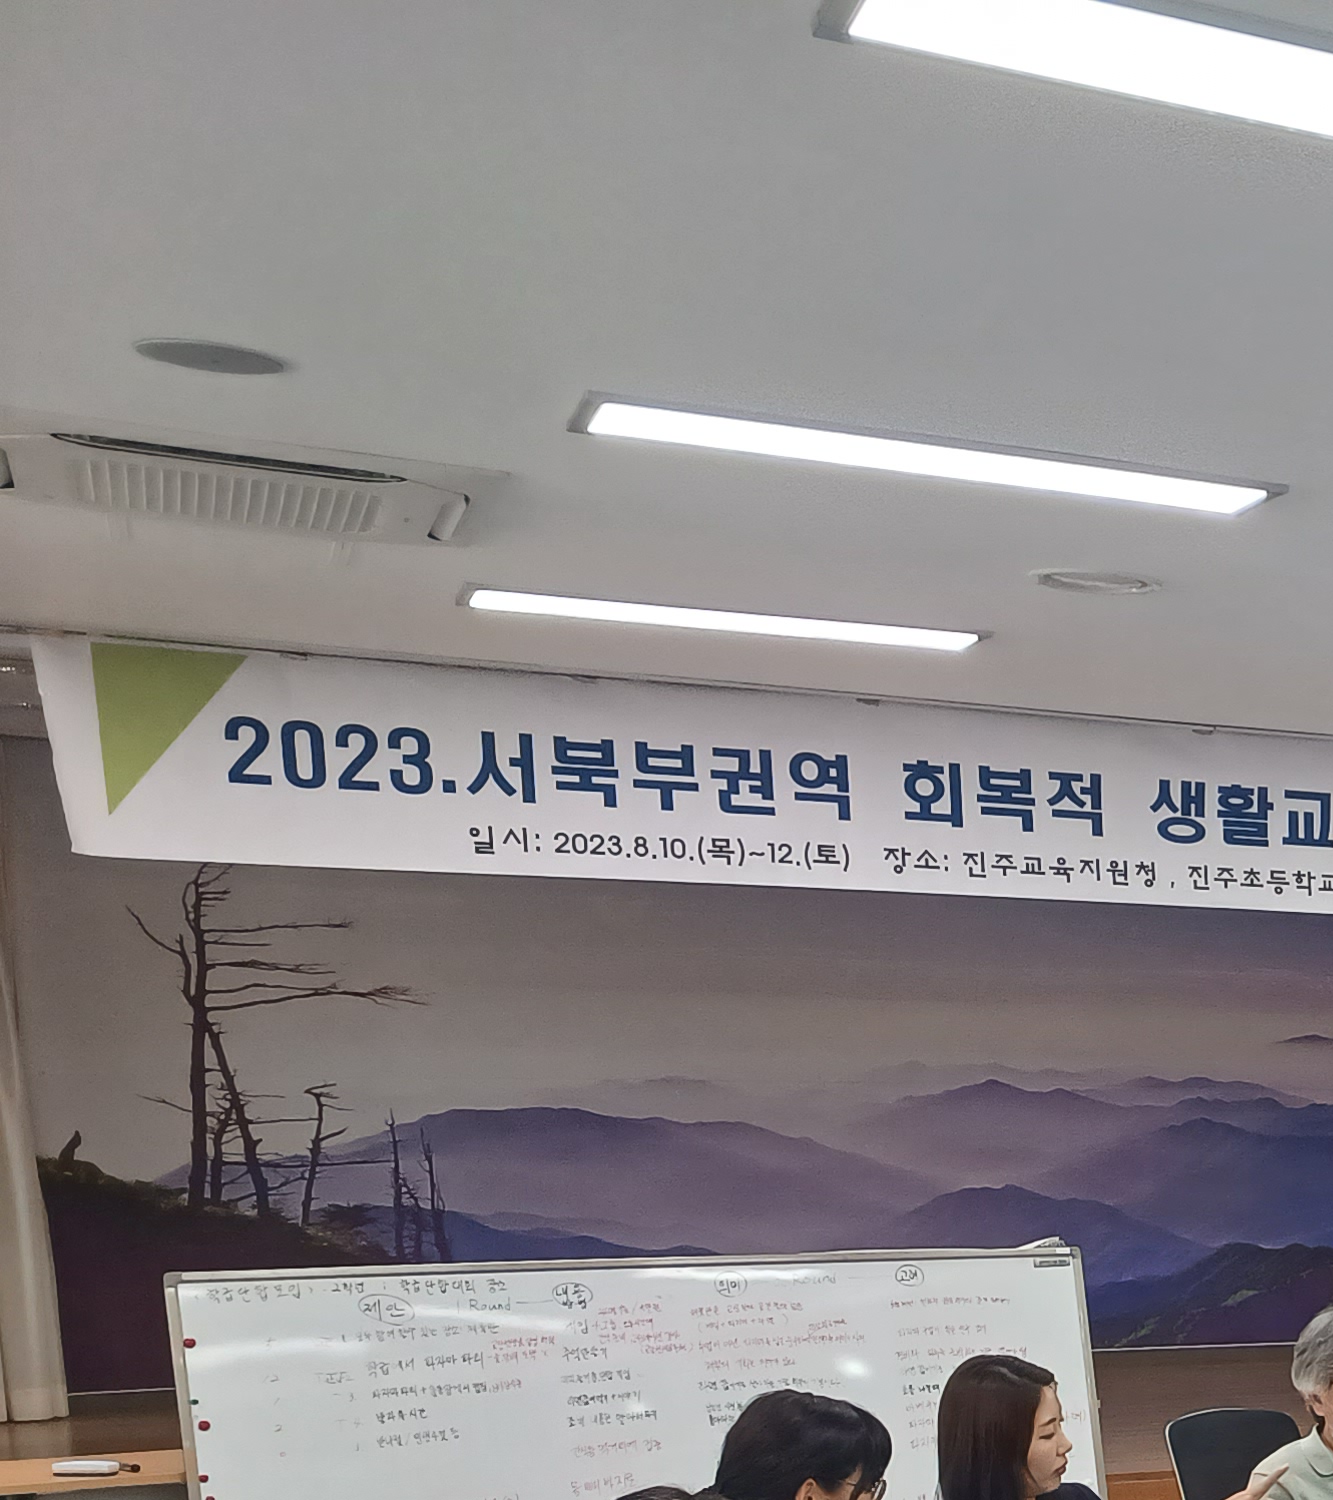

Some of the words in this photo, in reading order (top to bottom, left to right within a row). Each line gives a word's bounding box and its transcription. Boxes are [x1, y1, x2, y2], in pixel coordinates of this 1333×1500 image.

[224, 715, 852, 822] 2023.서북부권역
[902, 759, 1105, 838] 회복적
[469, 825, 541, 855] 일시:
[553, 831, 850, 869] 2023.8.10.(목)~12.(토)
[883, 846, 949, 875] 장소:
[362, 1298, 405, 1322] 제안
[469, 1296, 511, 1312] Round
